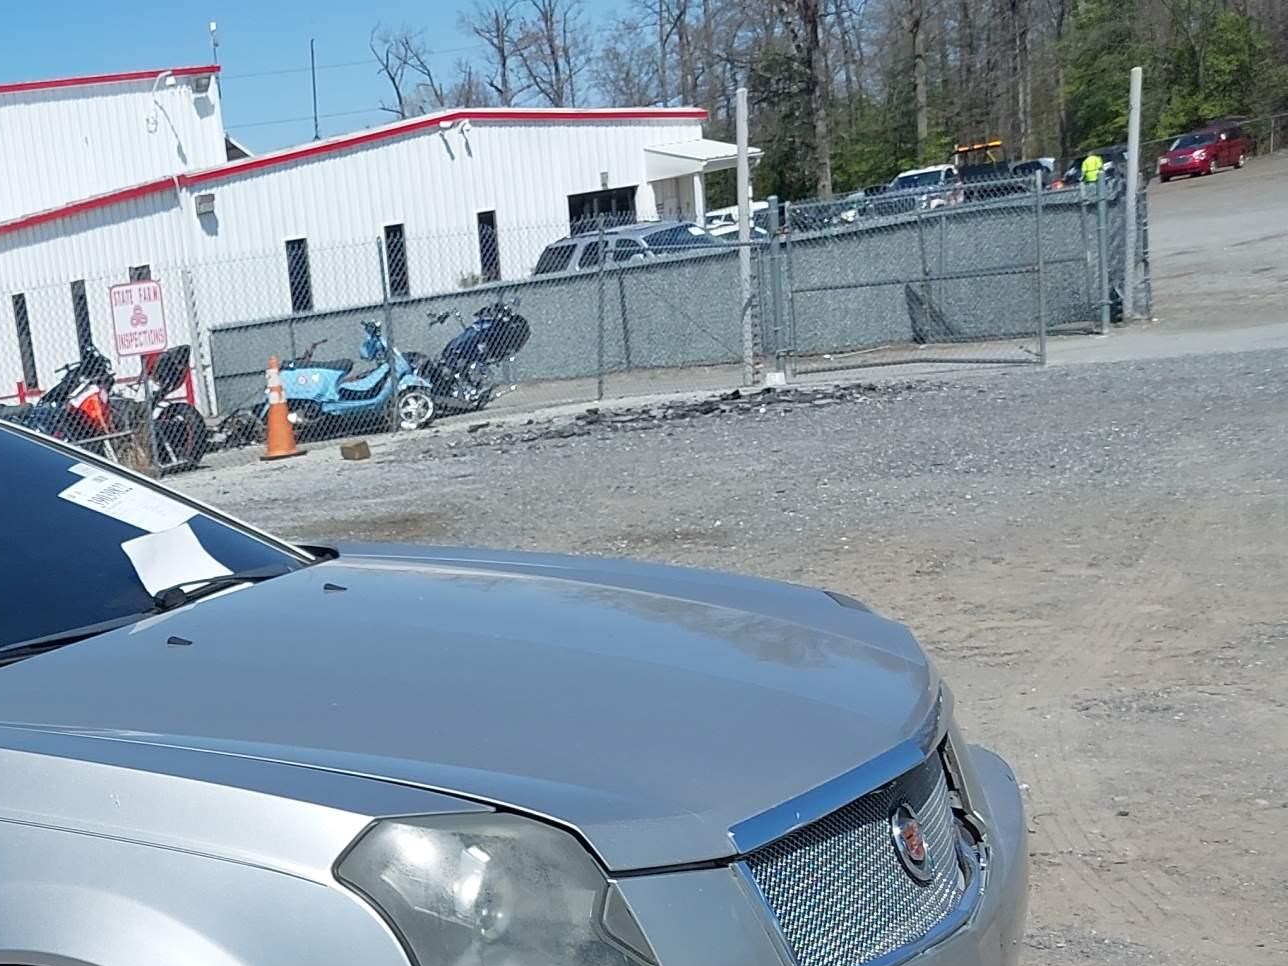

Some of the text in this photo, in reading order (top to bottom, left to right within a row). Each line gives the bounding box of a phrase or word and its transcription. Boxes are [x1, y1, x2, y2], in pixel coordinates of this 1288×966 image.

[113, 285, 160, 307] STATE FARM
[118, 327, 165, 351] INSPECTIONS
